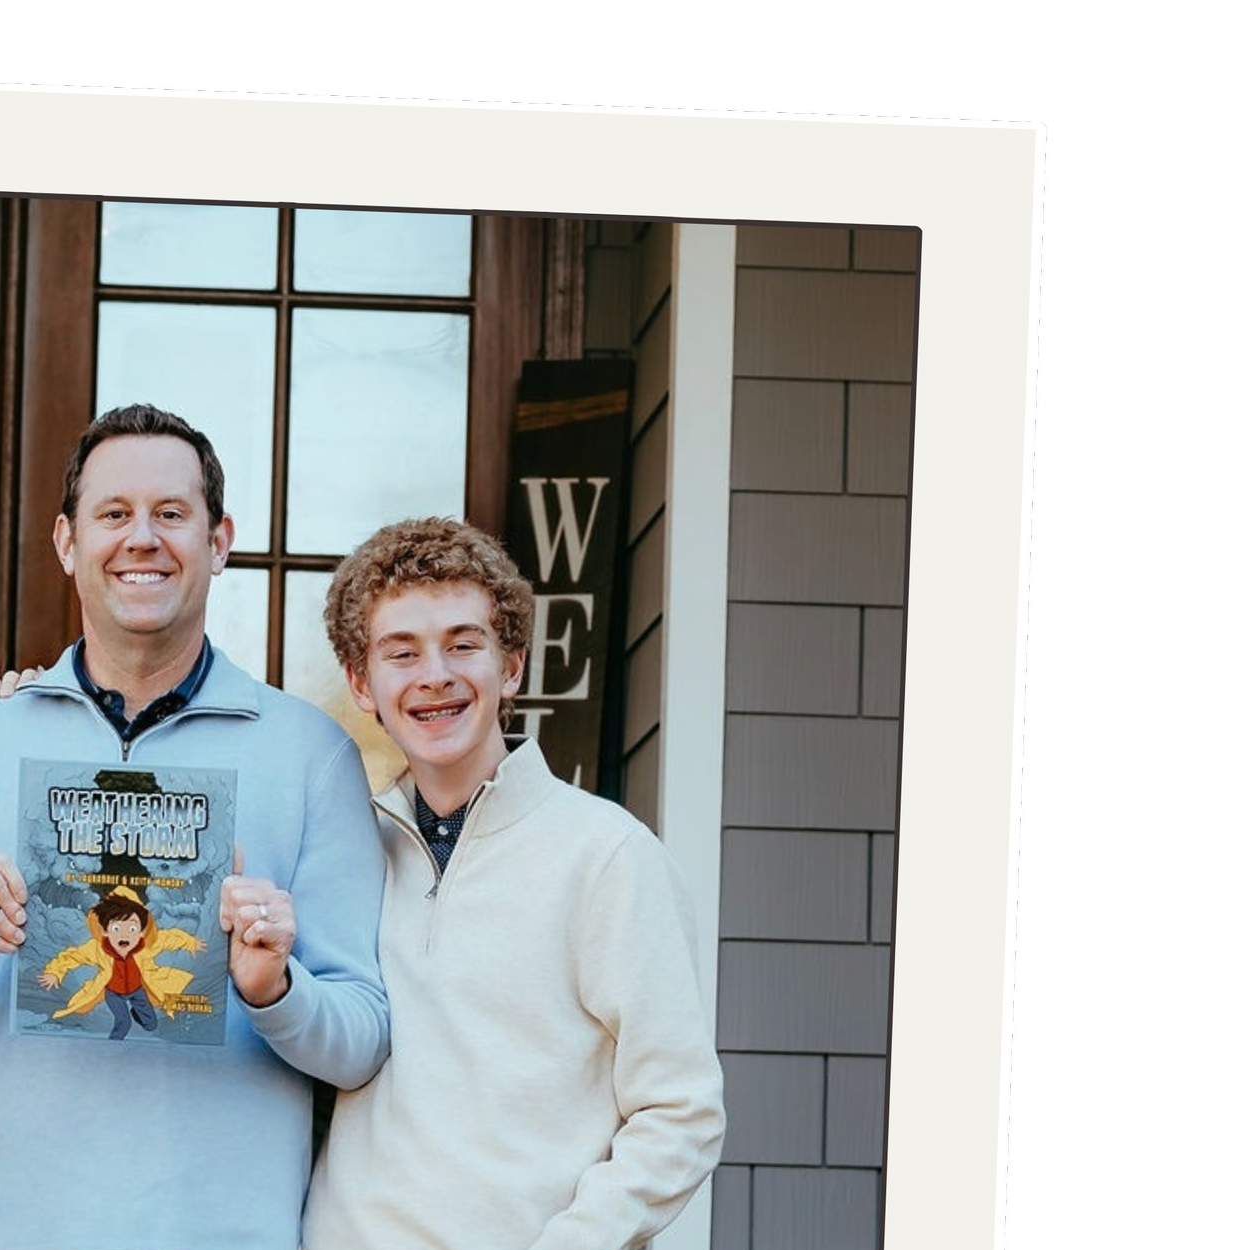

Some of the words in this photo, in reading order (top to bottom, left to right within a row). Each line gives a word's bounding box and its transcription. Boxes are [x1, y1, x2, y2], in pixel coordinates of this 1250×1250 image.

[50, 788, 207, 830] WEATHERING
[58, 821, 103, 854] THE
[110, 822, 197, 860] STORM
